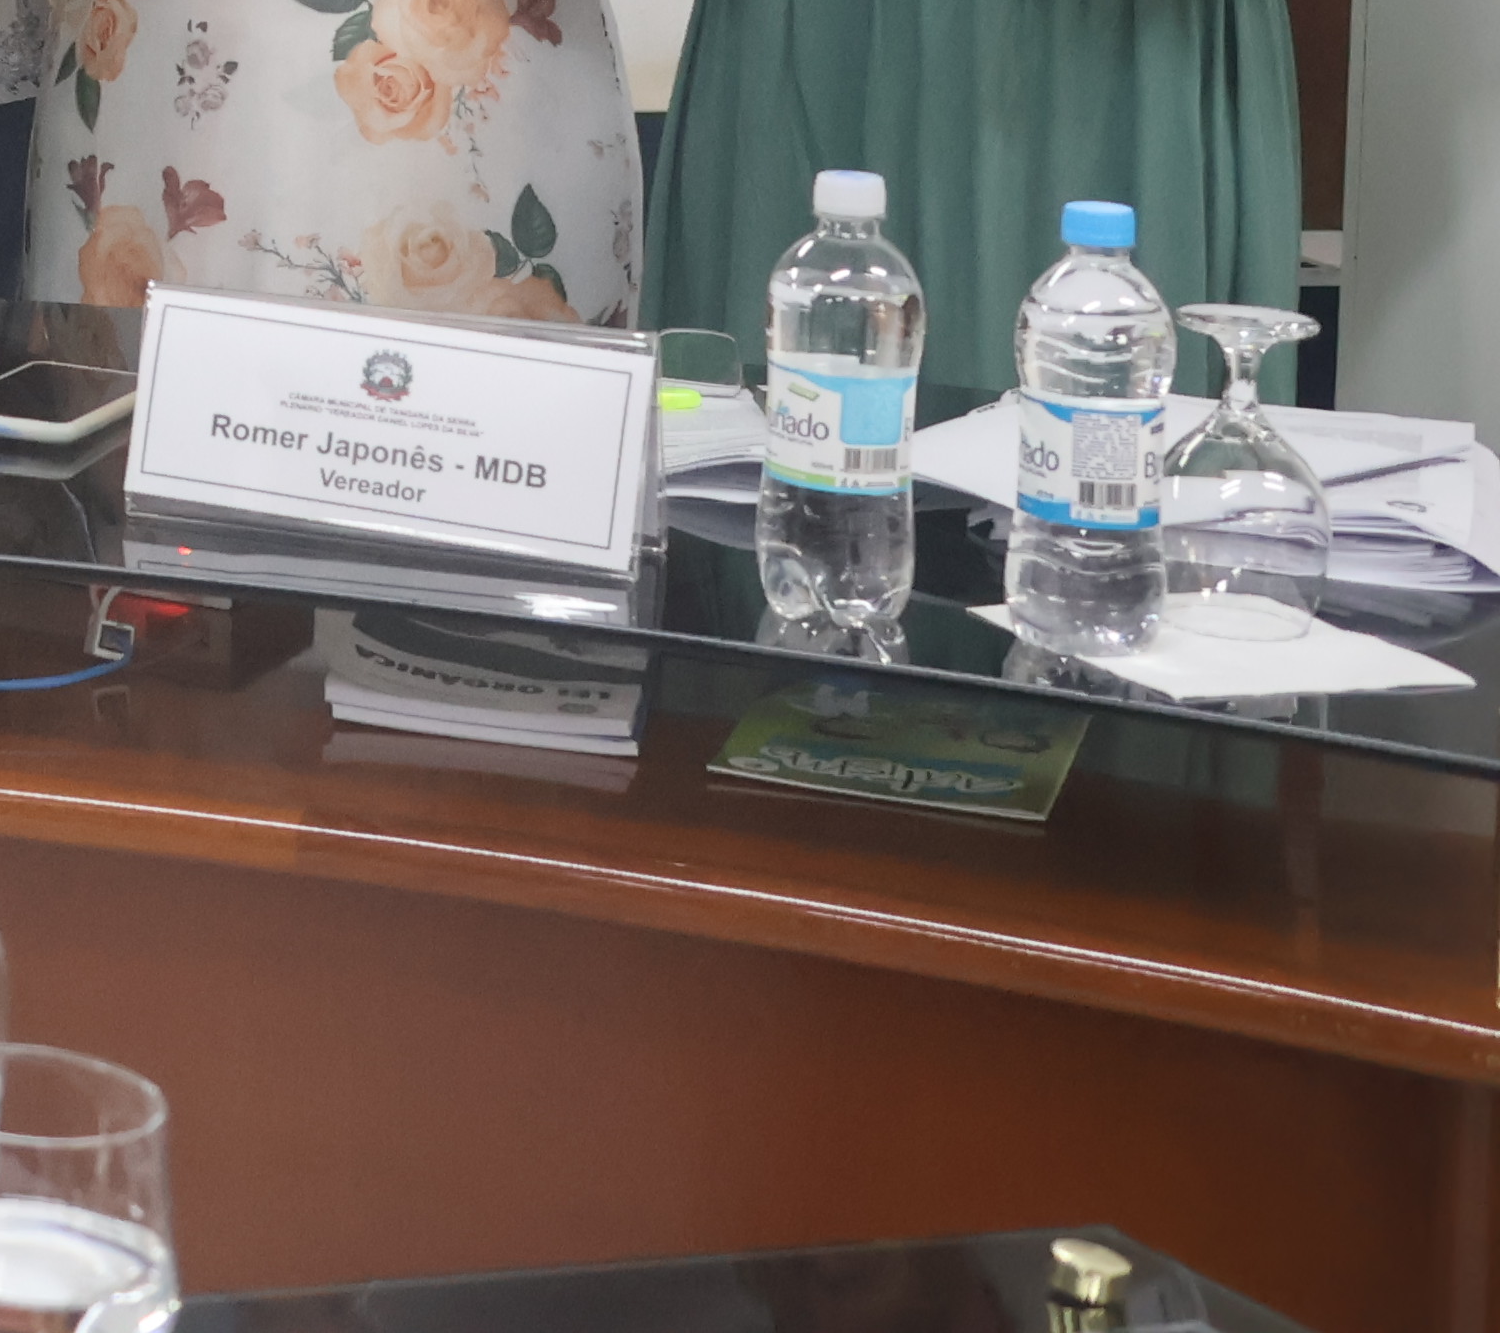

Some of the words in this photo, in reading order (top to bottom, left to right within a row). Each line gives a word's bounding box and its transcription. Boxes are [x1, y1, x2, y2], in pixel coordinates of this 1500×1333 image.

[211, 414, 309, 453] Romer
[316, 430, 444, 475] Japonês
[475, 454, 548, 490] MDB
[319, 468, 426, 504] Vereador
